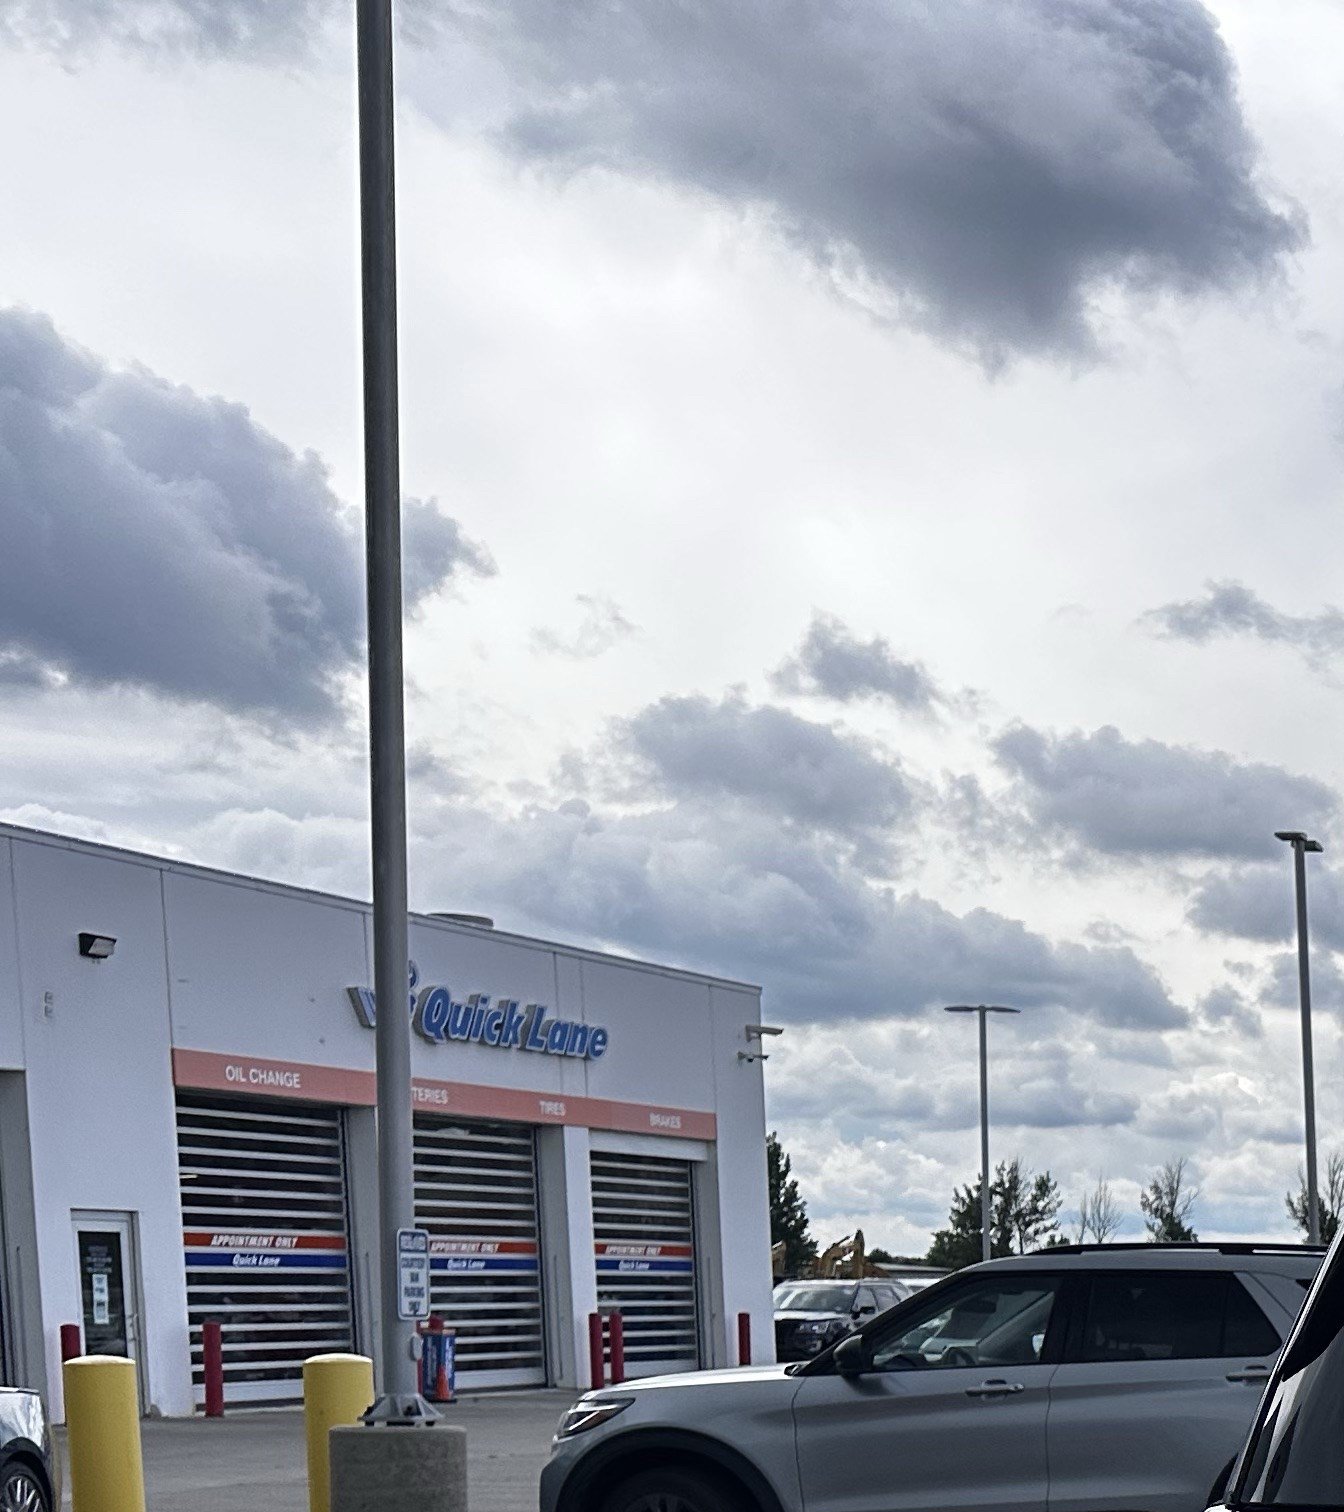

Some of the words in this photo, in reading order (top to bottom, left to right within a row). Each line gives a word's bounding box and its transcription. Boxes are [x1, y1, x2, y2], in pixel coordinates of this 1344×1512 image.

[420, 986, 525, 1048] Quick
[525, 1003, 609, 1060] Lane
[225, 1065, 246, 1083] OIL
[249, 1068, 301, 1089] CHANGE
[411, 1086, 448, 1105] TERIES
[539, 1100, 566, 1116] TIRES
[210, 1234, 274, 1248] APPOINTMENT
[275, 1236, 299, 1248] ONLY
[232, 1253, 257, 1267] Quick
[258, 1255, 281, 1267] Lane
